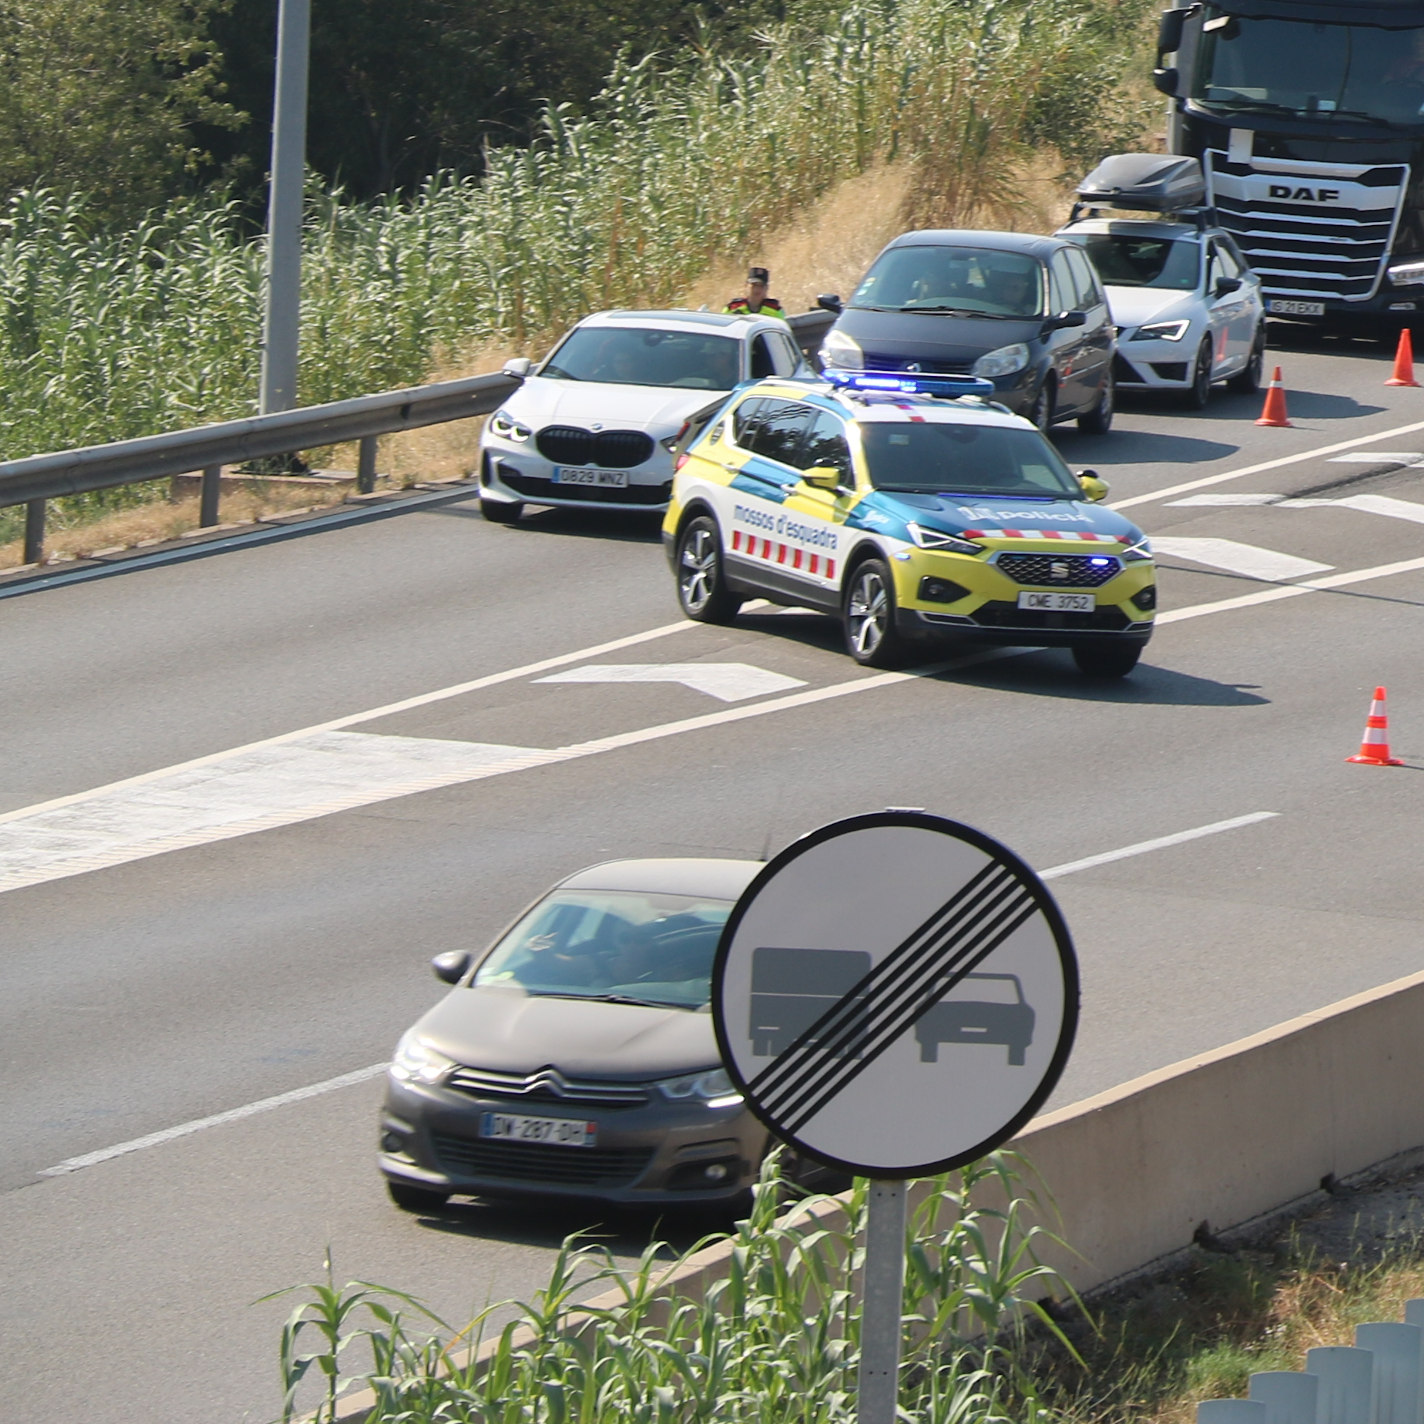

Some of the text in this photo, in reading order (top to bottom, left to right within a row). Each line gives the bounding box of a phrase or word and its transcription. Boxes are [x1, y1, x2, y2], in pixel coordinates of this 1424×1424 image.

[1269, 185, 1339, 202] DAF
[561, 469, 595, 483] 0829
[735, 504, 774, 531] mossos
[777, 514, 838, 550] d'esquadra
[1027, 596, 1089, 610] CME 3752
